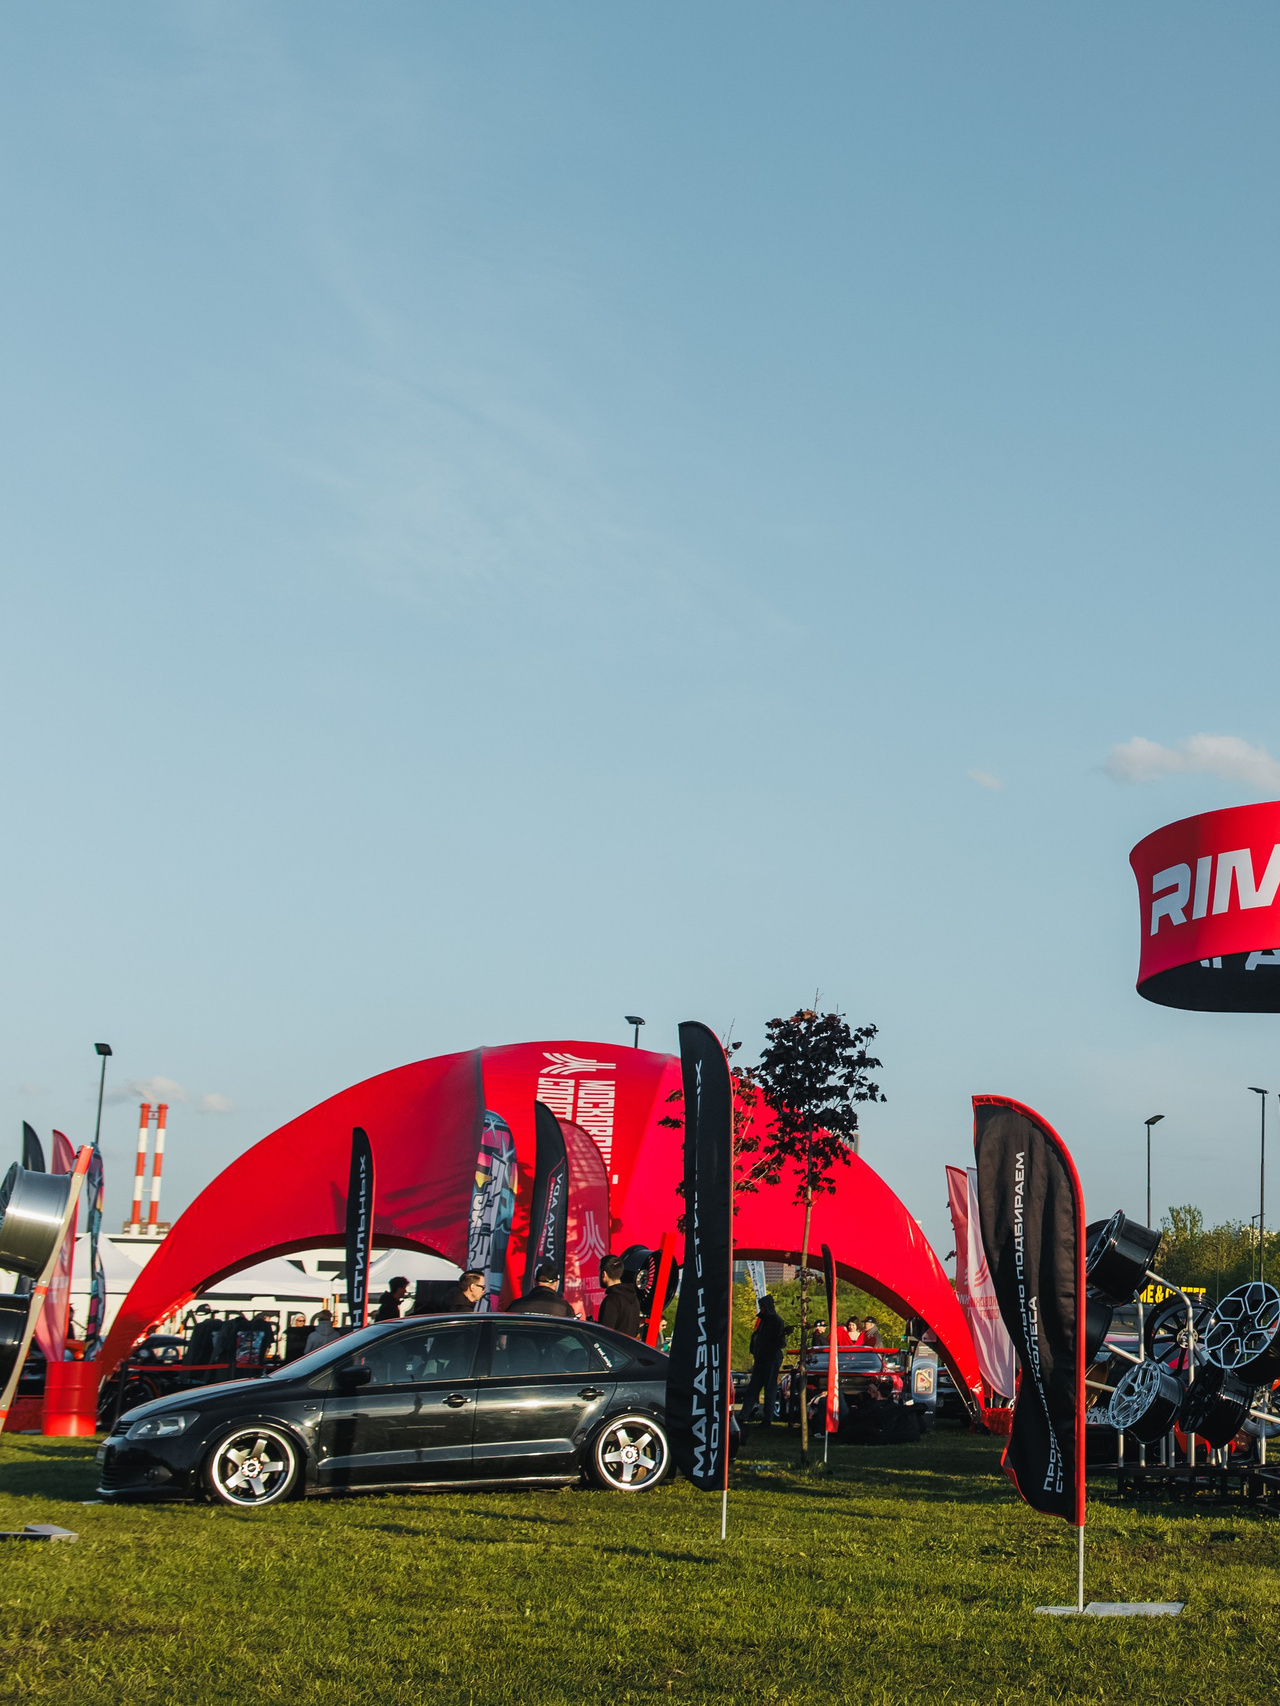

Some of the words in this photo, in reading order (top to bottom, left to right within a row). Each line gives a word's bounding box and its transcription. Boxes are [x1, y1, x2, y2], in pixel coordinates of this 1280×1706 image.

[353, 1155, 366, 1303] СТИЛЬНЫХ
[1015, 1151, 1026, 1280] ПОДБИРАЕМ
[691, 1289, 708, 1479] МАГАЗИН
[1028, 1296, 1040, 1378] КОЛЕСА
[706, 1342, 721, 1477] КОЛЕС
